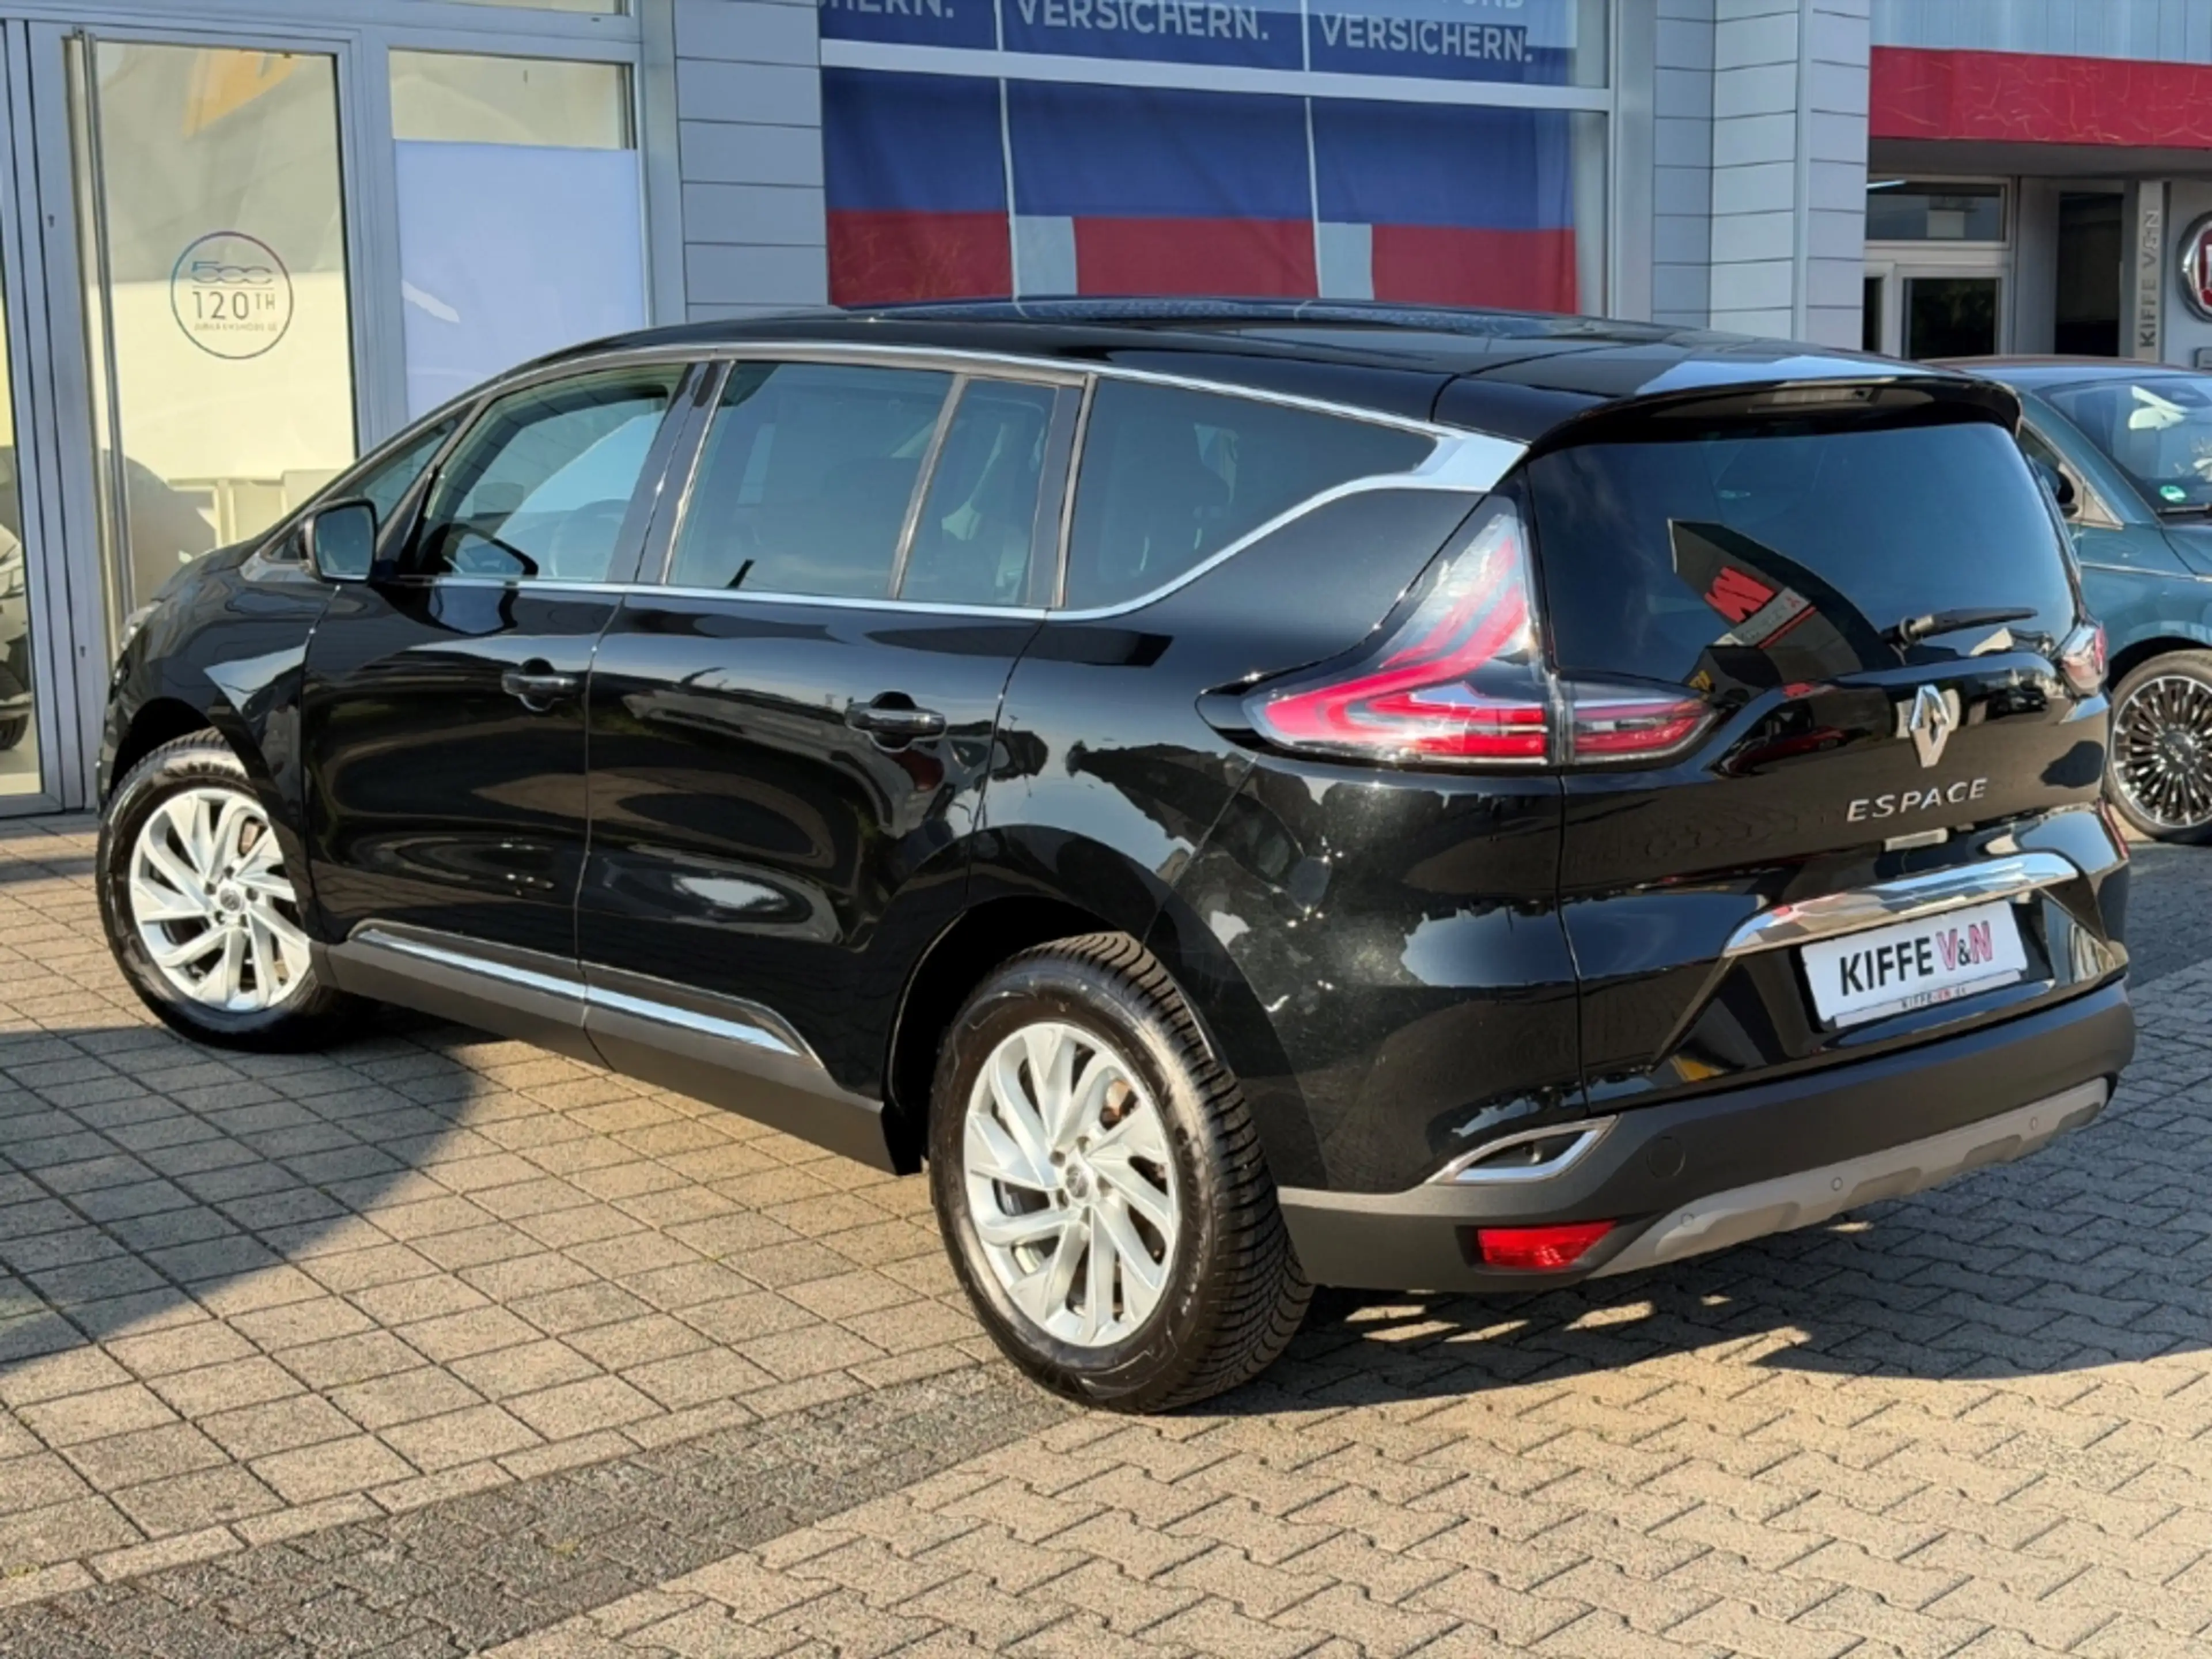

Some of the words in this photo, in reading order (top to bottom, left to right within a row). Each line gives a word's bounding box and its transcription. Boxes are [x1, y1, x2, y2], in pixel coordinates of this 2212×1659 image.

[1016, 0, 1270, 40] VERSICHERN.
[1319, 12, 1533, 63] VERSICHERN.
[2139, 278, 2156, 348] KIFFE
[1847, 778, 1987, 822] ESPACE
[1840, 937, 1934, 996] KIFFE
[1936, 920, 1993, 971] V&N
